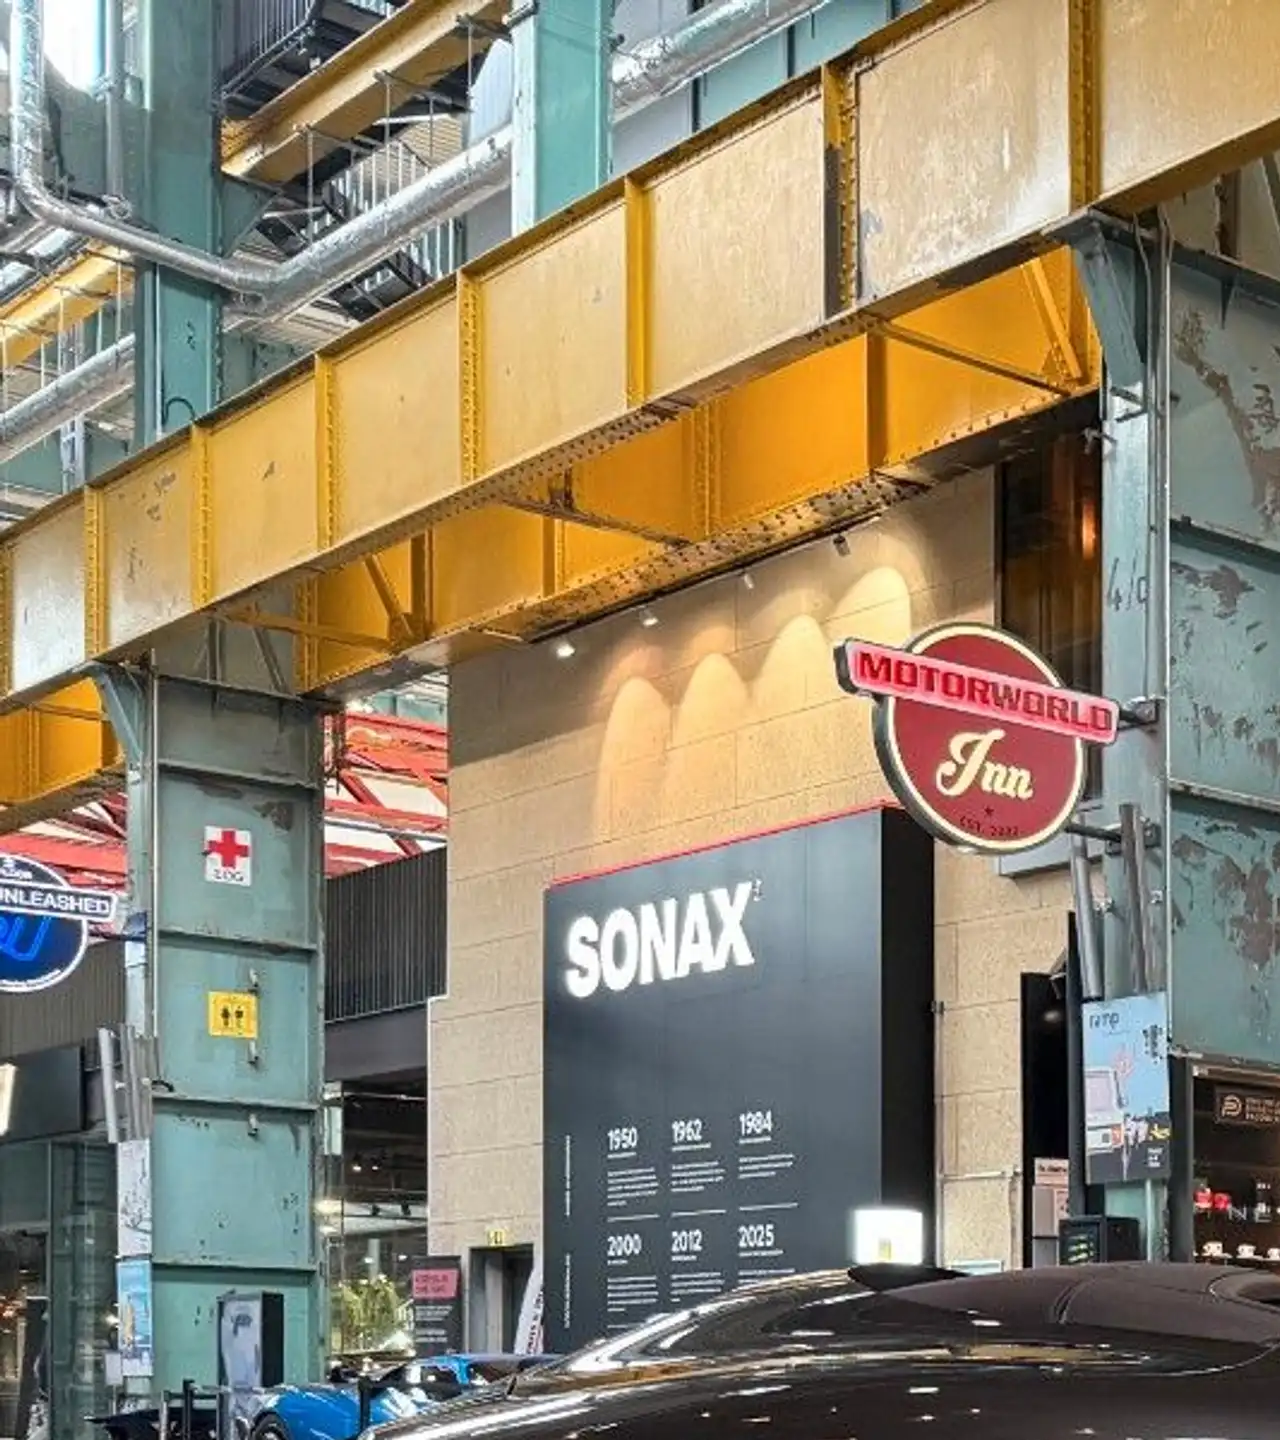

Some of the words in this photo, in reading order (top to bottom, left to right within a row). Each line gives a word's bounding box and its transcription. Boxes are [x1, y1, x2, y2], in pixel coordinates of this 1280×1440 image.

[857, 651, 1114, 732] MOTORWORLD
[935, 728, 1035, 801] Inn
[0, 887, 109, 914] NLEASHED
[565, 879, 755, 998] SONAX
[607, 1126, 638, 1151] 1950
[671, 1118, 703, 1143] 1962
[739, 1110, 773, 1135] 1984
[607, 1233, 642, 1257] 2000
[671, 1229, 703, 1252] 2012
[738, 1223, 775, 1248] 2025
